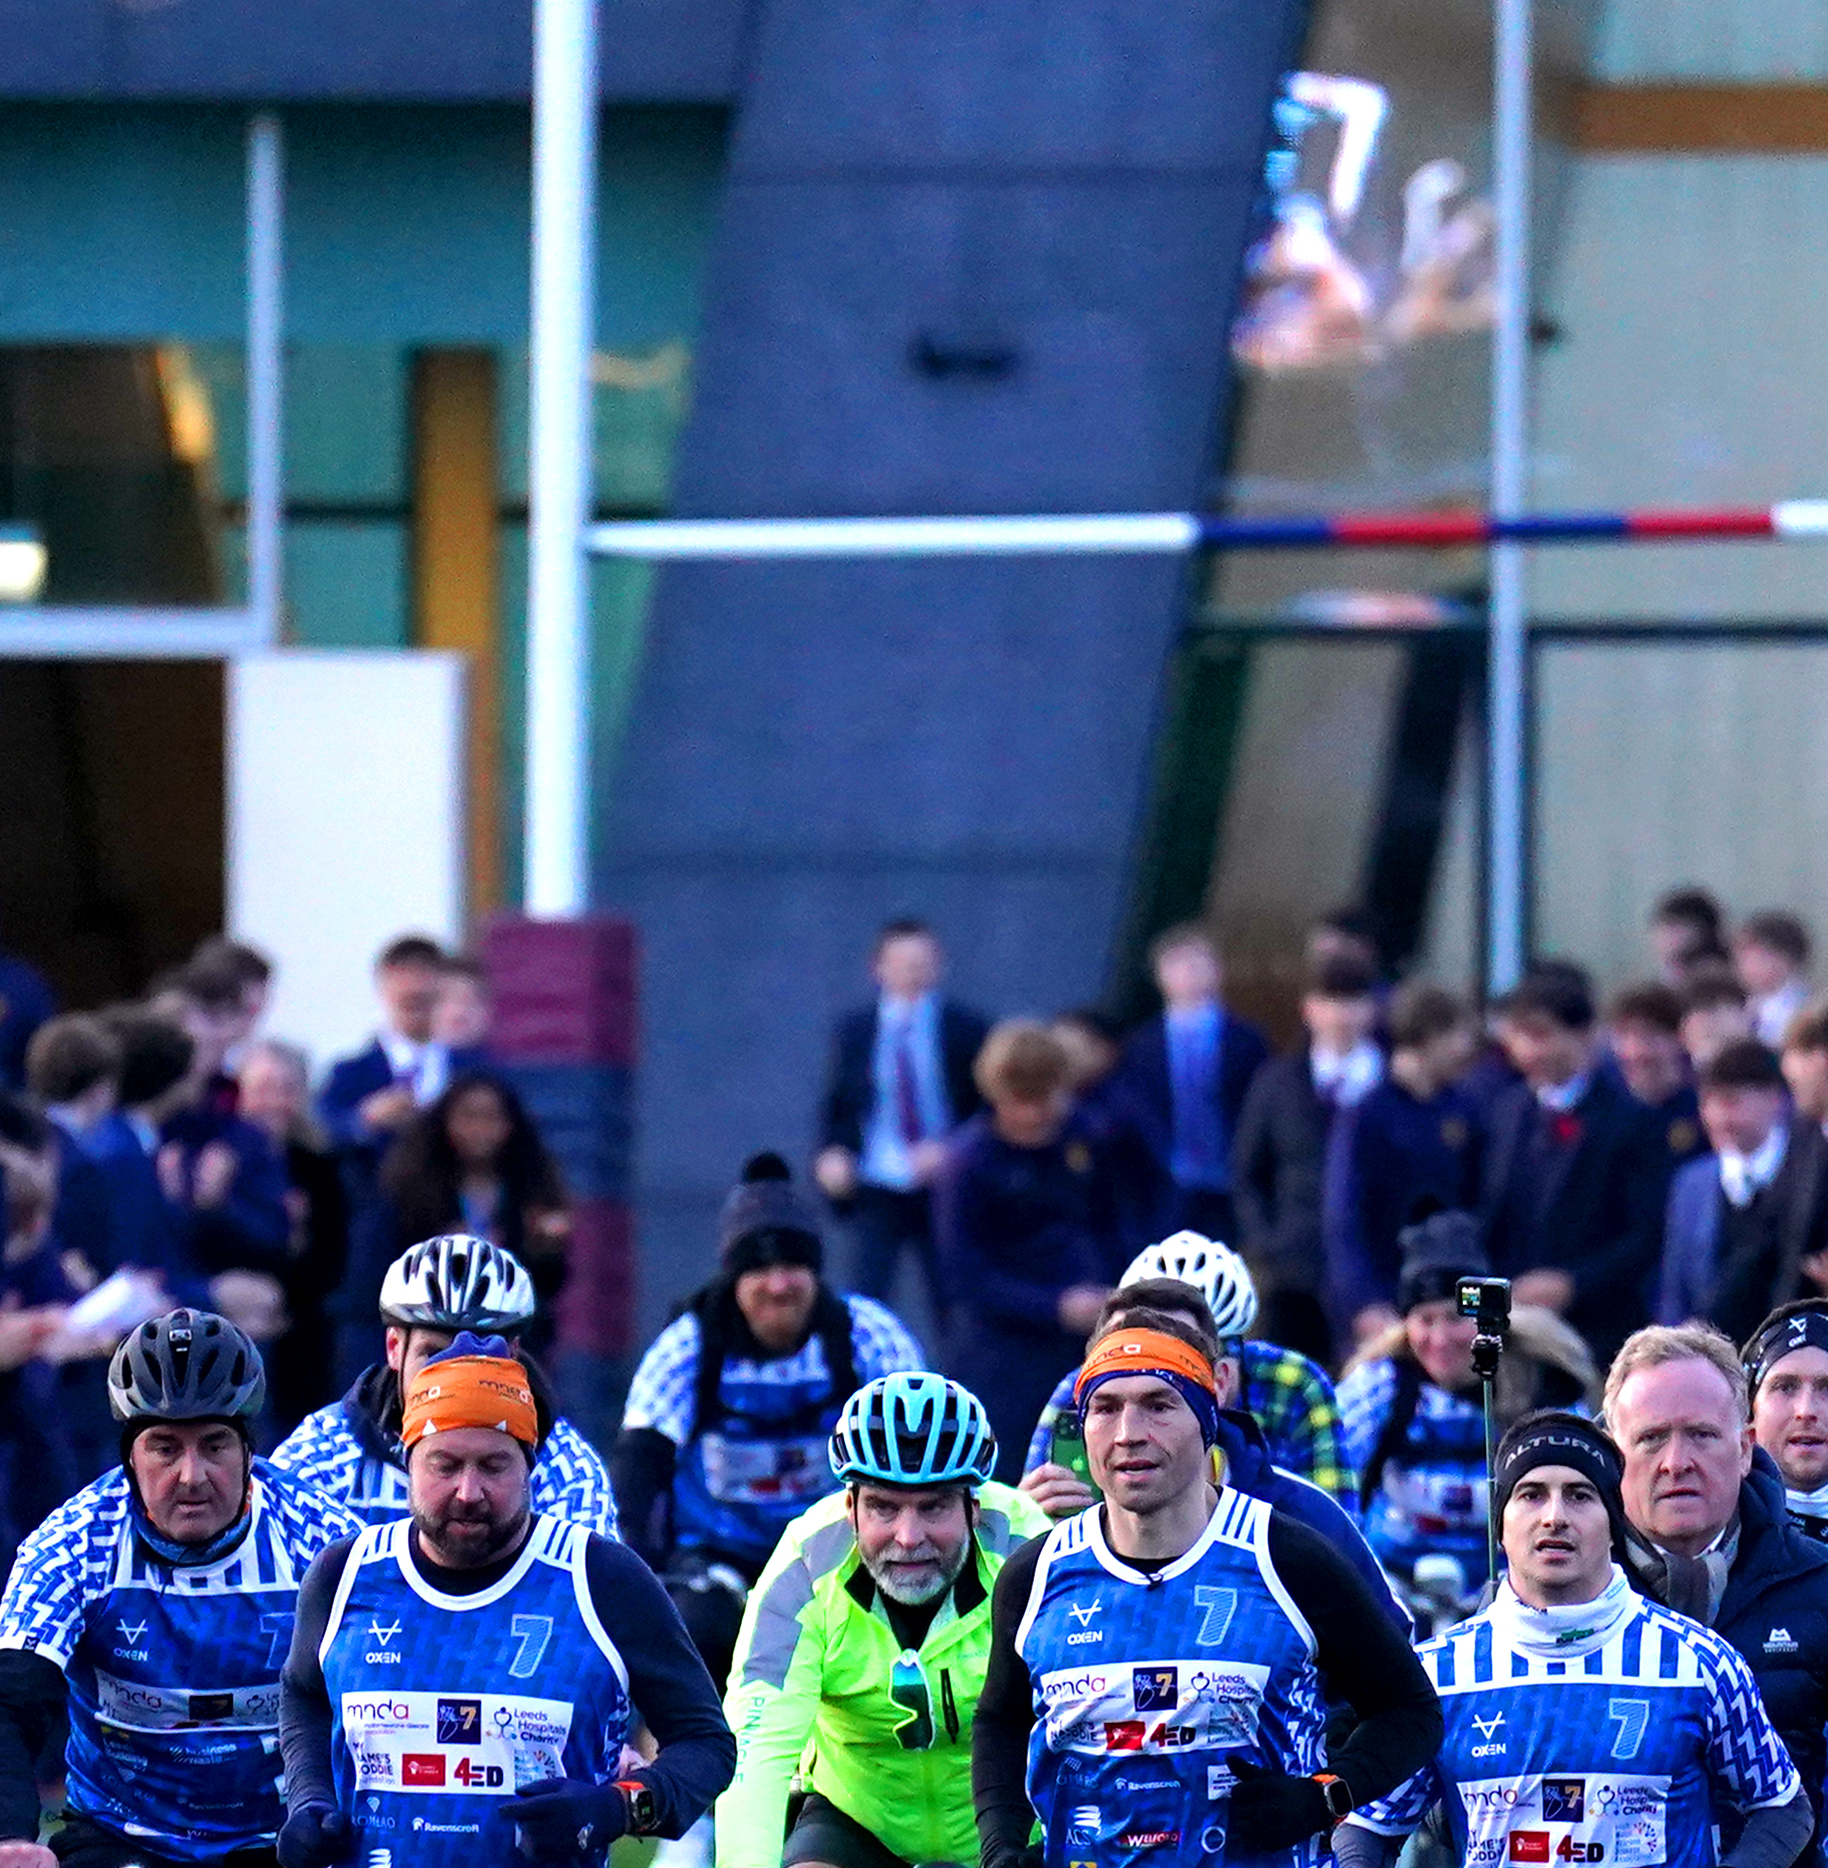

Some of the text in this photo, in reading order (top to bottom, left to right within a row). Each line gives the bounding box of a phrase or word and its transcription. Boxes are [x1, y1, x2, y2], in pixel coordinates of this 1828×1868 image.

[1504, 1435, 1605, 1470] ALTURA
[1194, 1584, 1237, 1647] 7
[508, 1613, 554, 1679] 7
[1067, 1630, 1103, 1645] OXEN
[113, 1647, 148, 1662] OXEN
[365, 1652, 401, 1664] OXEN
[1156, 1673, 1173, 1697] 7
[347, 1699, 409, 1720] mnda
[460, 1705, 477, 1730] 7
[514, 1708, 548, 1721] Leeds
[1608, 1697, 1650, 1760] 7
[1471, 1743, 1507, 1758] OXEN
[359, 1763, 394, 1776] ODDIE
[453, 1757, 504, 1787] 4ED
[1564, 1785, 1581, 1808] 7
[424, 1822, 479, 1833] Ravenscroft
[1556, 1835, 1604, 1864] 4ED
